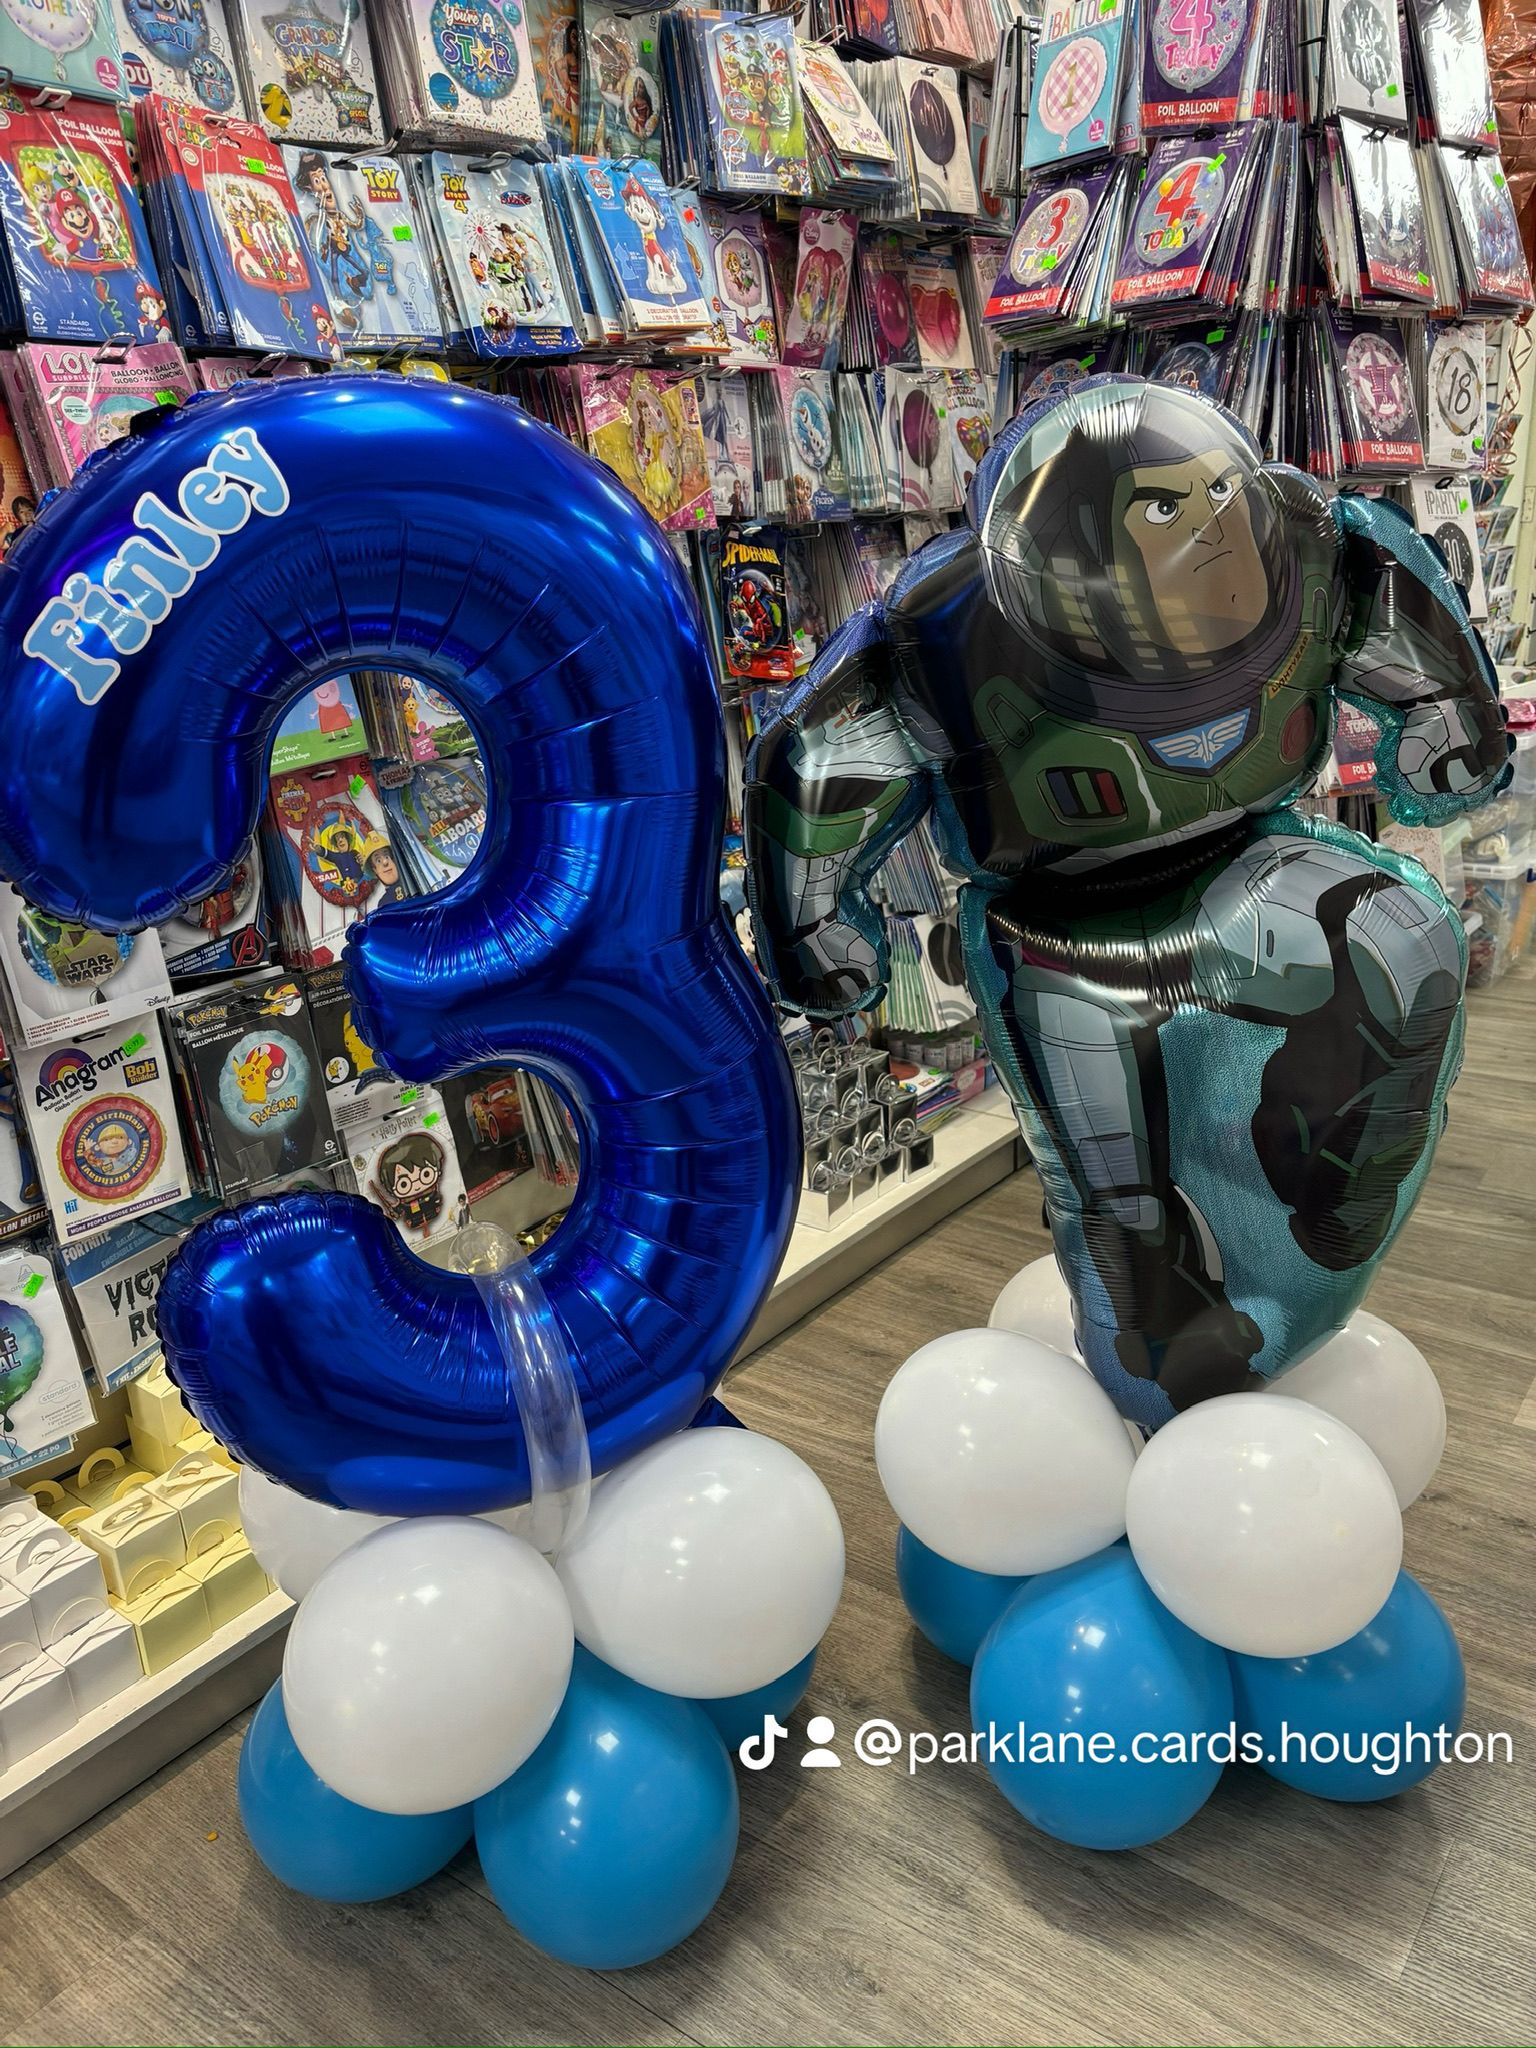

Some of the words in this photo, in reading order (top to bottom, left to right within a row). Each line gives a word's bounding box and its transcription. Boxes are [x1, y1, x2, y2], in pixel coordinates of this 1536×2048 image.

[1158, 106, 1176, 117] FOIL
[1179, 101, 1220, 116] BALLOON
[361, 167, 399, 190] TOY
[441, 173, 466, 193] TOY
[370, 189, 399, 200] STORY
[445, 191, 469, 201] STORY
[1155, 163, 1202, 229] 4
[454, 199, 468, 215] 4
[1035, 196, 1071, 249] 3
[1143, 224, 1195, 251] TODAY
[1128, 279, 1144, 290] FOIL
[1146, 271, 1183, 287] BALLOON
[1000, 297, 1014, 308] FOIL
[1015, 292, 1048, 306] BALLOON
[111, 368, 148, 378] BALLOON
[153, 361, 180, 373] BALLON
[114, 376, 139, 384] GLOBO
[144, 370, 184, 382] PALLONCINO
[1448, 366, 1471, 415] 18
[1371, 444, 1386, 454] FOIL
[1387, 444, 1413, 456] BALLOON
[722, 541, 781, 568] SPIDER-MAN
[23, 426, 290, 705] Finley
[1352, 765, 1367, 775] FOIL
[430, 820, 449, 836] ALL
[440, 809, 487, 846] ABOARD
[65, 954, 113, 975] STAR
[66, 962, 115, 985] WARS
[202, 1022, 227, 1034] BALLOON
[192, 1039, 213, 1049] BALLON
[213, 1027, 244, 1042] MÉTALLIQUE
[36, 1046, 130, 1107] Anagram
[125, 1060, 156, 1078] Bob
[43, 1099, 65, 1112] Balloon
[54, 1101, 71, 1112] Globo
[20, 1209, 48, 1228] MÉTALL
[70, 1225, 86, 1235] MORE
[87, 1217, 107, 1230] PEOPLE
[108, 1209, 129, 1220] CHOOSE
[129, 1200, 153, 1214] ANAGRAM
[154, 1191, 180, 1203] BALLOONS
[61, 1231, 112, 1266] FORTNITE
[42, 1383, 78, 1401] standard
